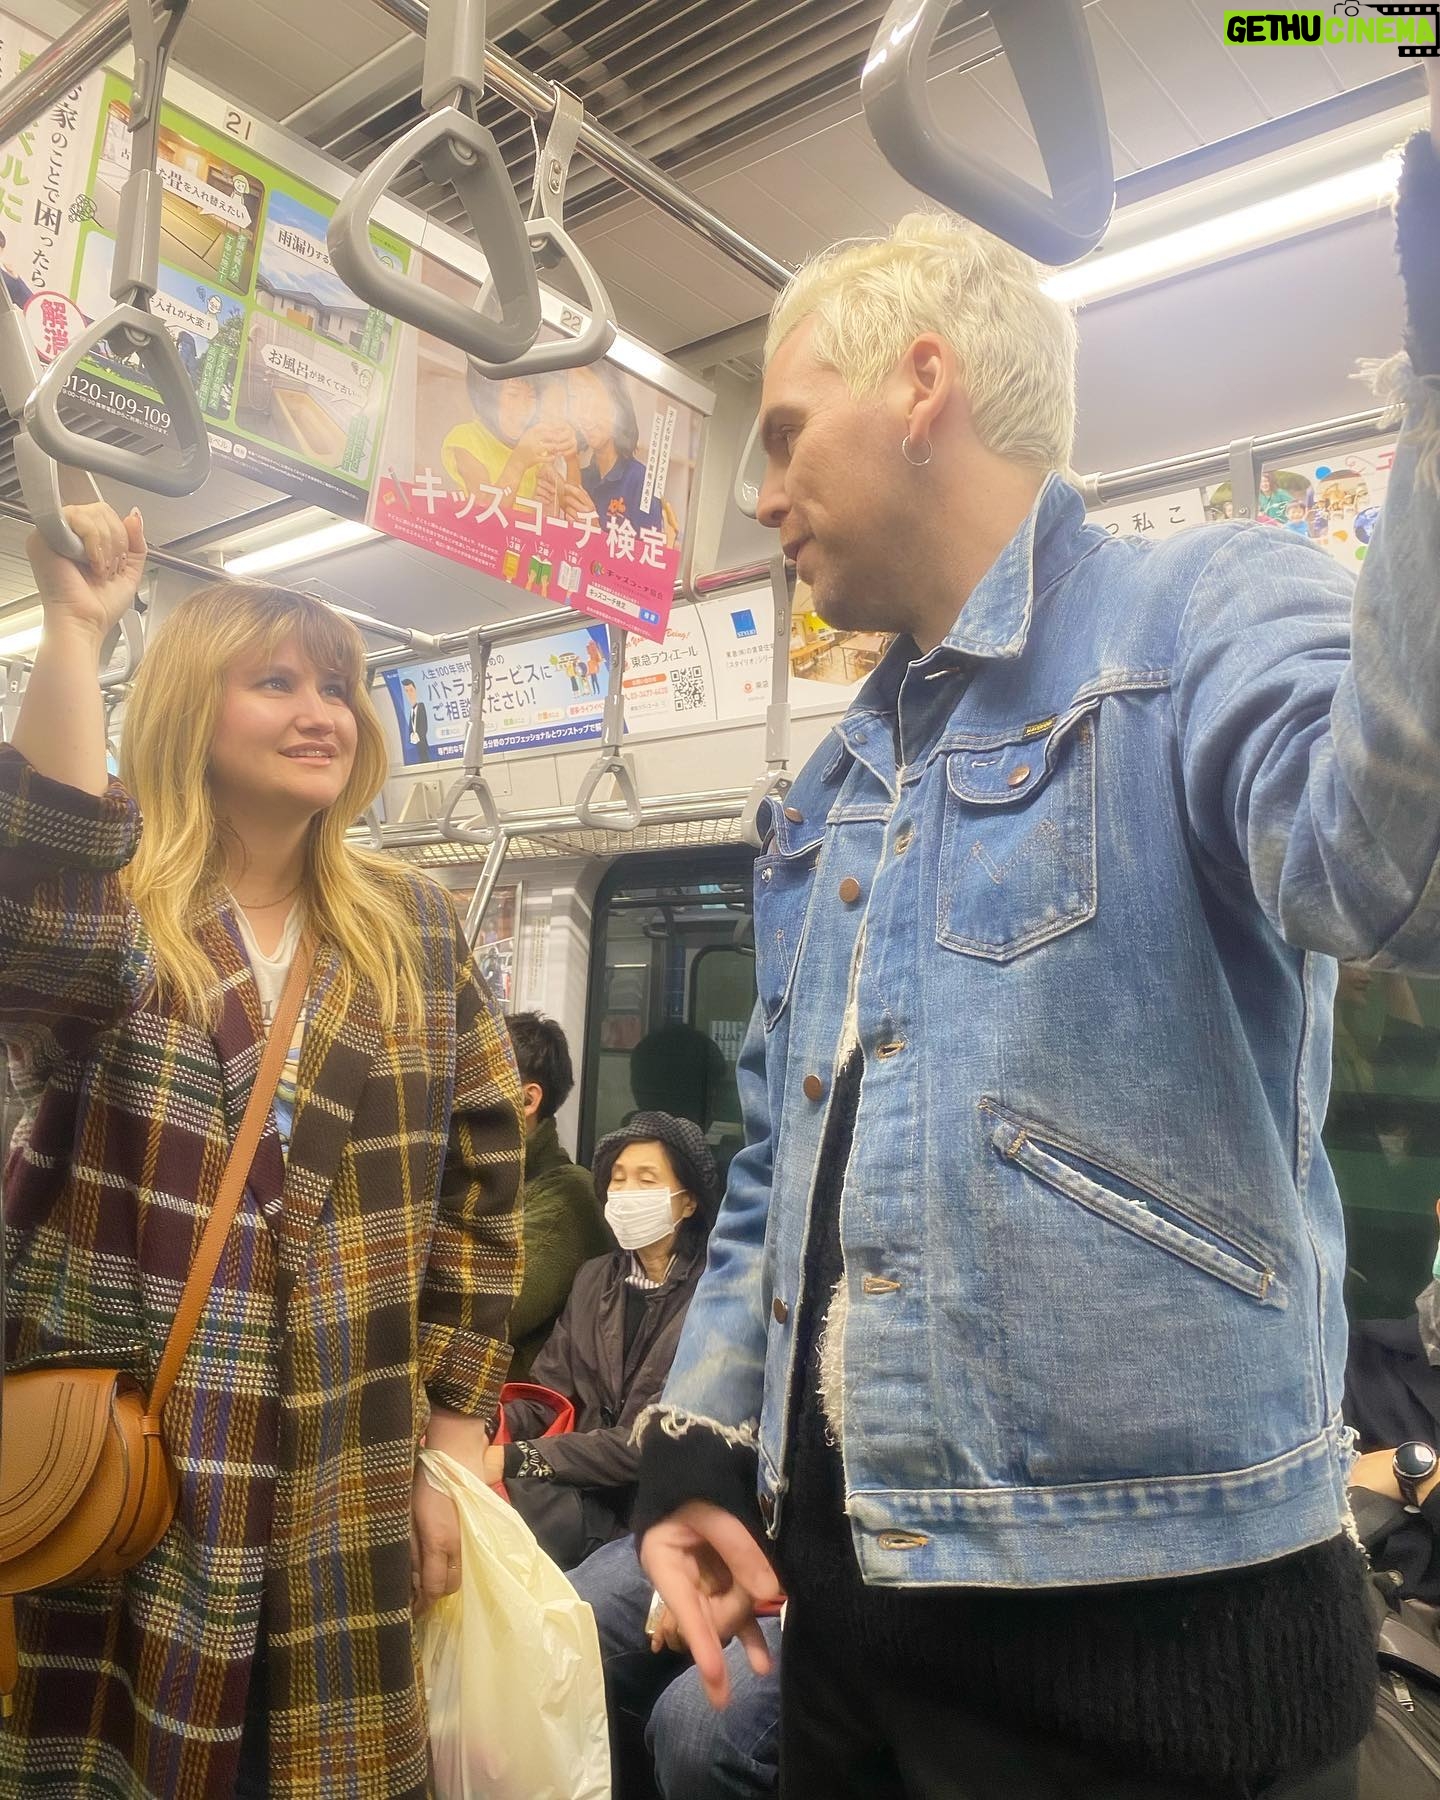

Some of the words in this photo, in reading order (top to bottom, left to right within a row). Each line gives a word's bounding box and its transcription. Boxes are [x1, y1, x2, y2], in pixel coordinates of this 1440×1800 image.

[226, 110, 251, 141] 21
[278, 229, 335, 267] 雨漏りする
[40, 298, 69, 355] 解消
[561, 310, 583, 330] 22
[411, 467, 668, 570] キッズコーチ検定
[1132, 511, 1155, 534] 私
[1168, 505, 1186, 524] こ
[422, 654, 505, 681] 人生100年時代めの
[433, 686, 537, 722] ご相談ださい！
